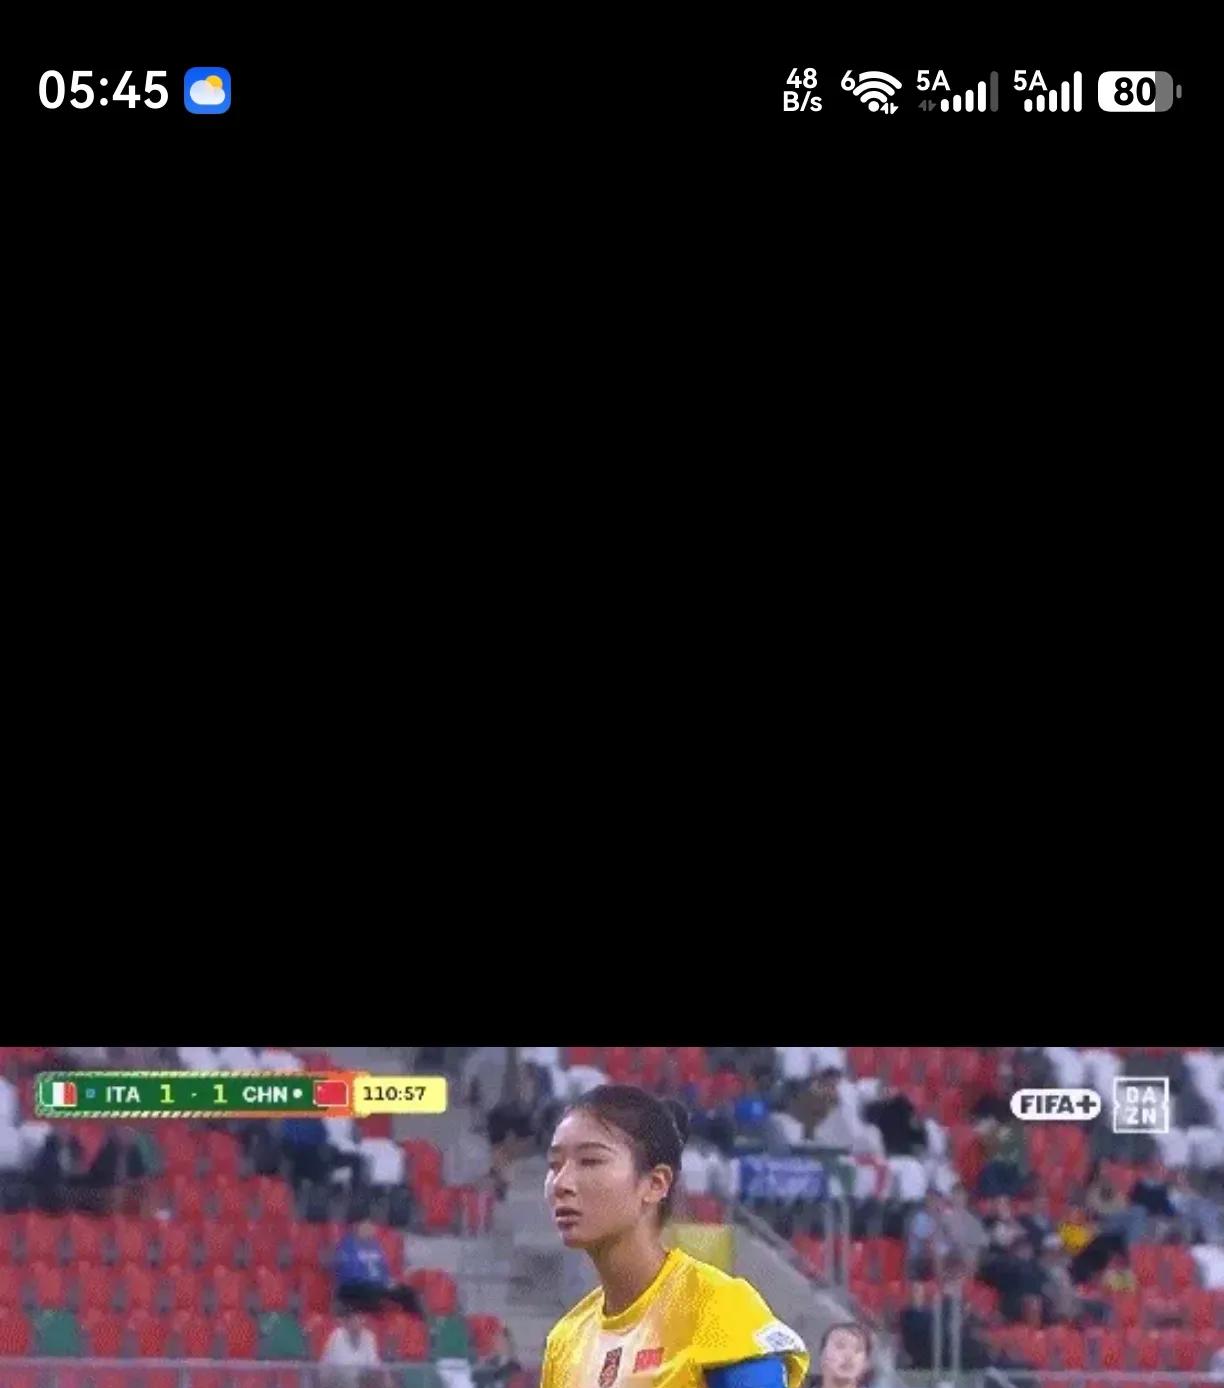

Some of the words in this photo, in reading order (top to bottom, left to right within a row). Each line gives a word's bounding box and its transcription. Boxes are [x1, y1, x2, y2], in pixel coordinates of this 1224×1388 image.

[38, 69, 169, 110] 05:45
[786, 67, 818, 89] 48
[840, 69, 856, 92] 6
[916, 69, 951, 92] 5A
[1013, 69, 1048, 92] 5A
[783, 90, 823, 112] B/s
[1113, 76, 1157, 106] 80
